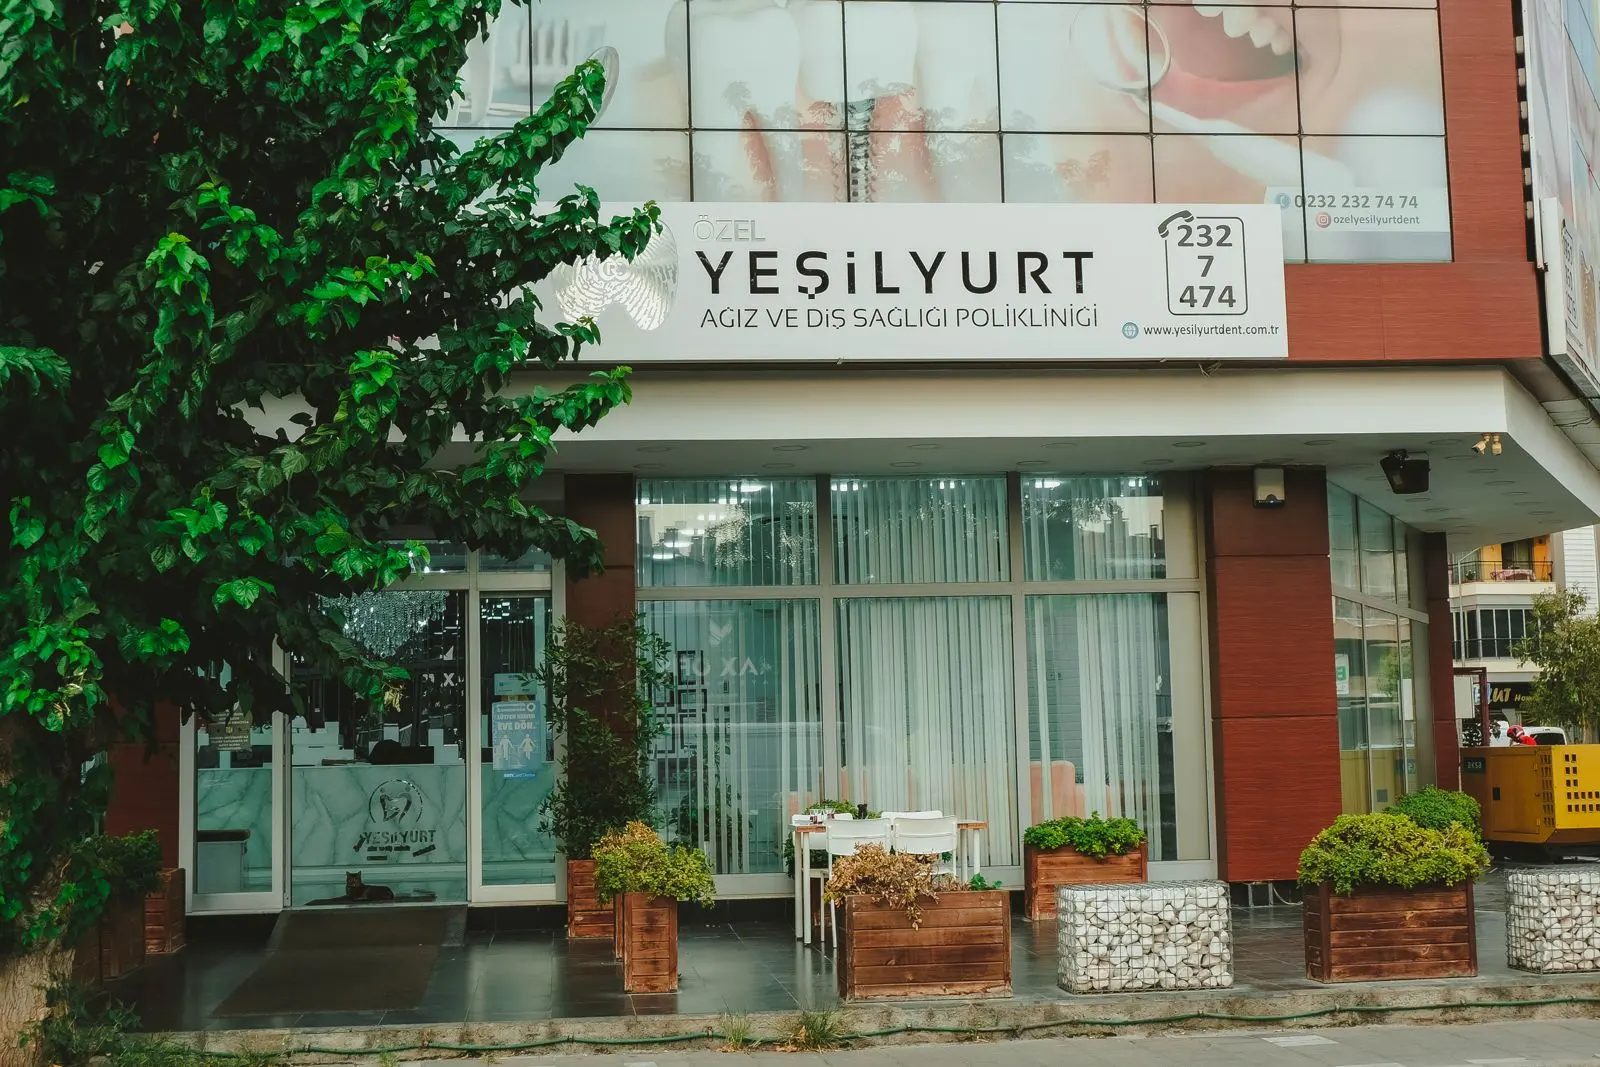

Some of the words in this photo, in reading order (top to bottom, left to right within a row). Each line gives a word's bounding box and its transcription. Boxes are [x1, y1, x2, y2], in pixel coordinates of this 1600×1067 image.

[1294, 194, 1337, 208] 0232
[1341, 195, 1370, 208] 232
[1375, 195, 1394, 208] 74
[1399, 195, 1418, 208] 74
[692, 214, 766, 242] ÖZEL
[1333, 214, 1420, 226] ozelyesilyurtdent
[1177, 224, 1233, 247] 232
[1197, 255, 1214, 278] 7
[1179, 285, 1236, 308] 474
[700, 306, 759, 328] AĞIZ
[766, 308, 799, 328] VE
[853, 306, 947, 328] SAĞLIĞI
[956, 303, 1098, 328] POLİKLİNİĞİ
[1143, 324, 1279, 337] www.yesilyurtdent.com.tr
